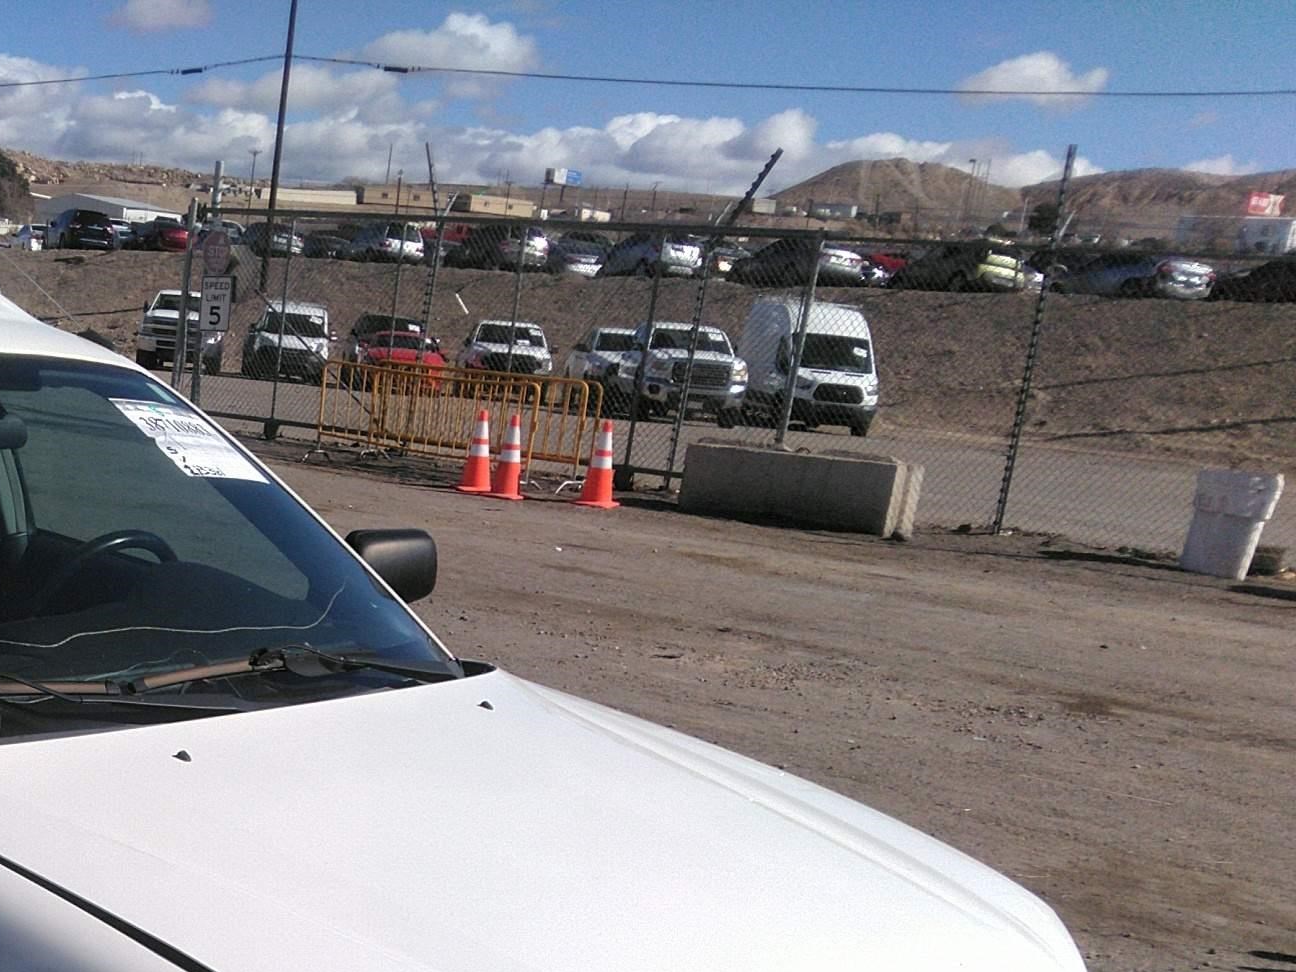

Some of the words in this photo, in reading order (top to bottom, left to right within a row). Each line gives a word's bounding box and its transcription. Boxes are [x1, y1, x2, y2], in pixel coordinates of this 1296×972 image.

[204, 281, 230, 290] SPEED
[206, 294, 227, 303] LIMIT
[208, 306, 221, 325] 5
